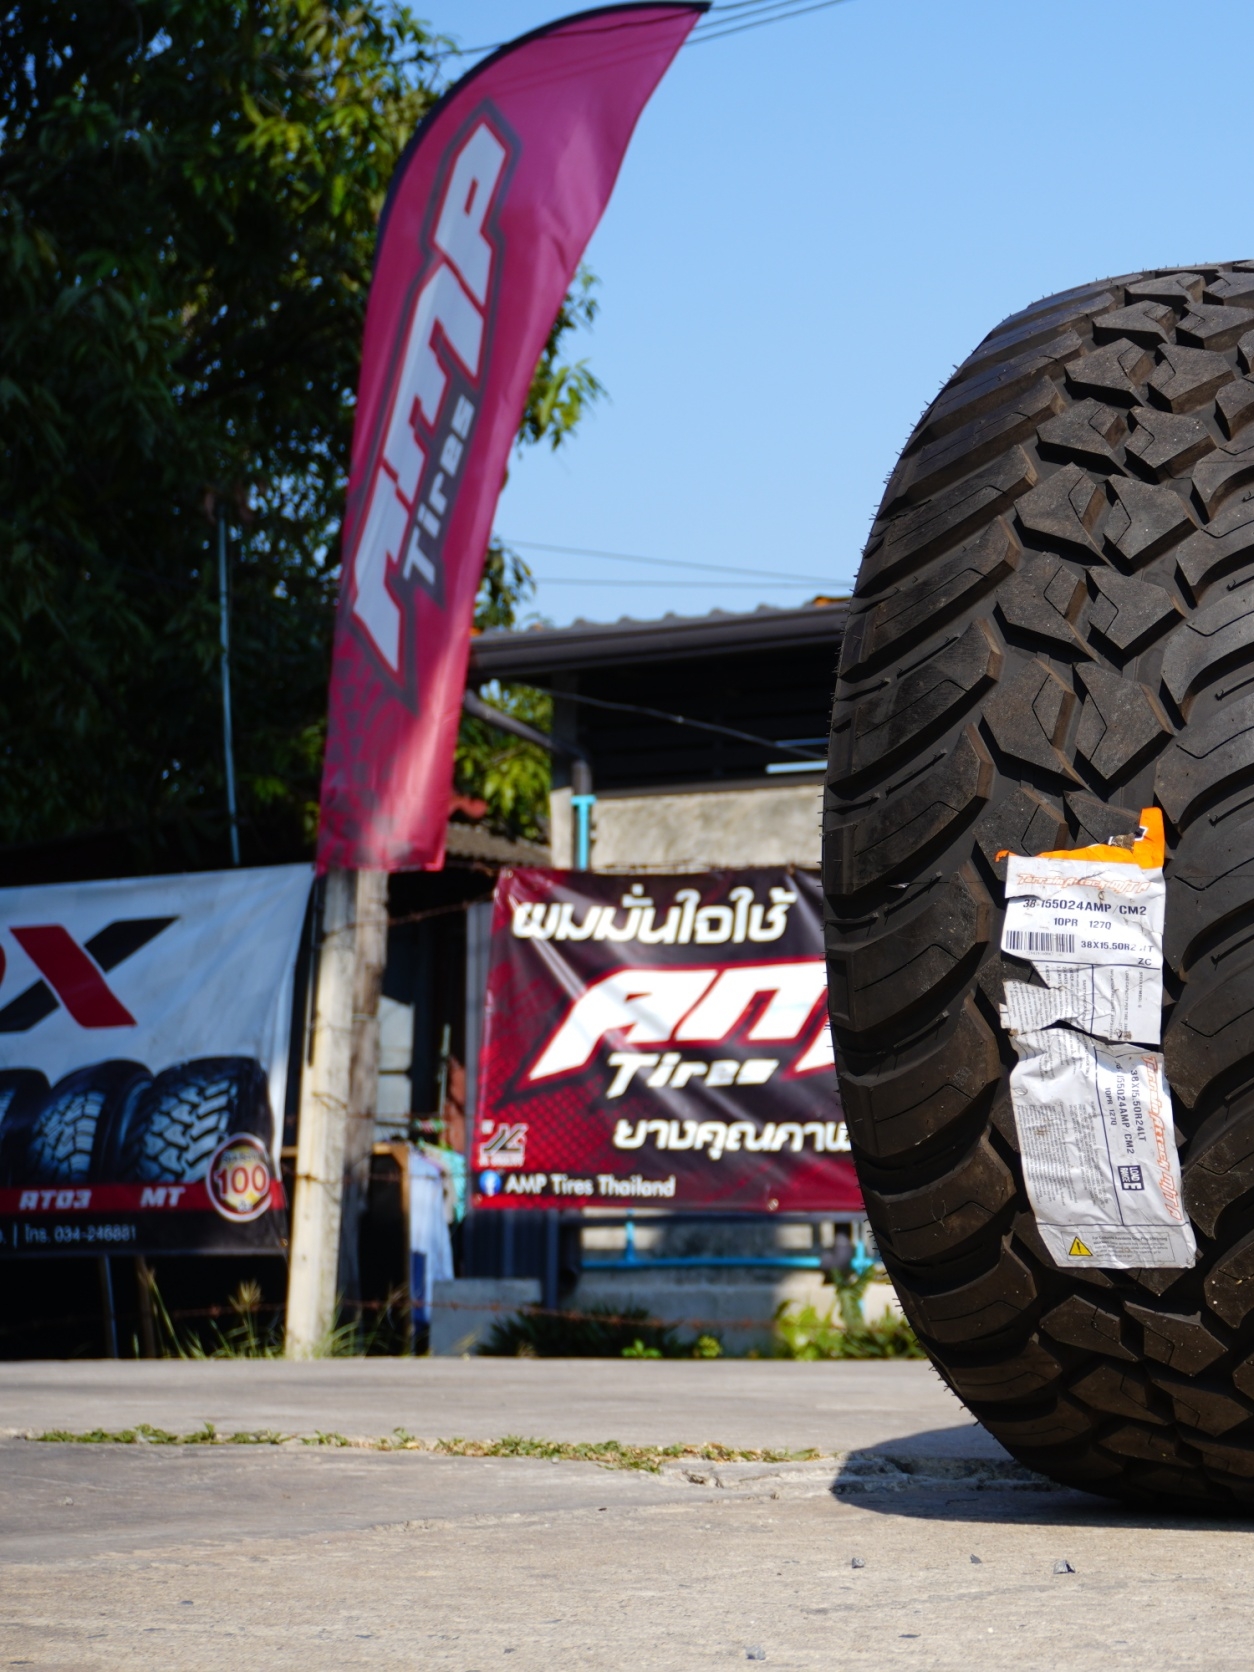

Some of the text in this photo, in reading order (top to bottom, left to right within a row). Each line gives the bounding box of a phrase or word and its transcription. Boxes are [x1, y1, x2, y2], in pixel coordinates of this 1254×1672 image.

[401, 393, 474, 590] Tires
[1053, 917, 1112, 930] 10PR 127Q
[1137, 957, 1153, 966] ZC
[606, 1052, 779, 1099] Tires
[1104, 1087, 1118, 1126] 10PR 127Q
[1130, 1069, 1147, 1142] 38X15.50R24LT
[215, 1163, 269, 1198] 100
[504, 1173, 676, 1197] AMP Tires Thailand
[1119, 1166, 1131, 1183] RANGE
[1129, 1166, 1140, 1182] LOAD
[140, 1186, 186, 1208] MT
